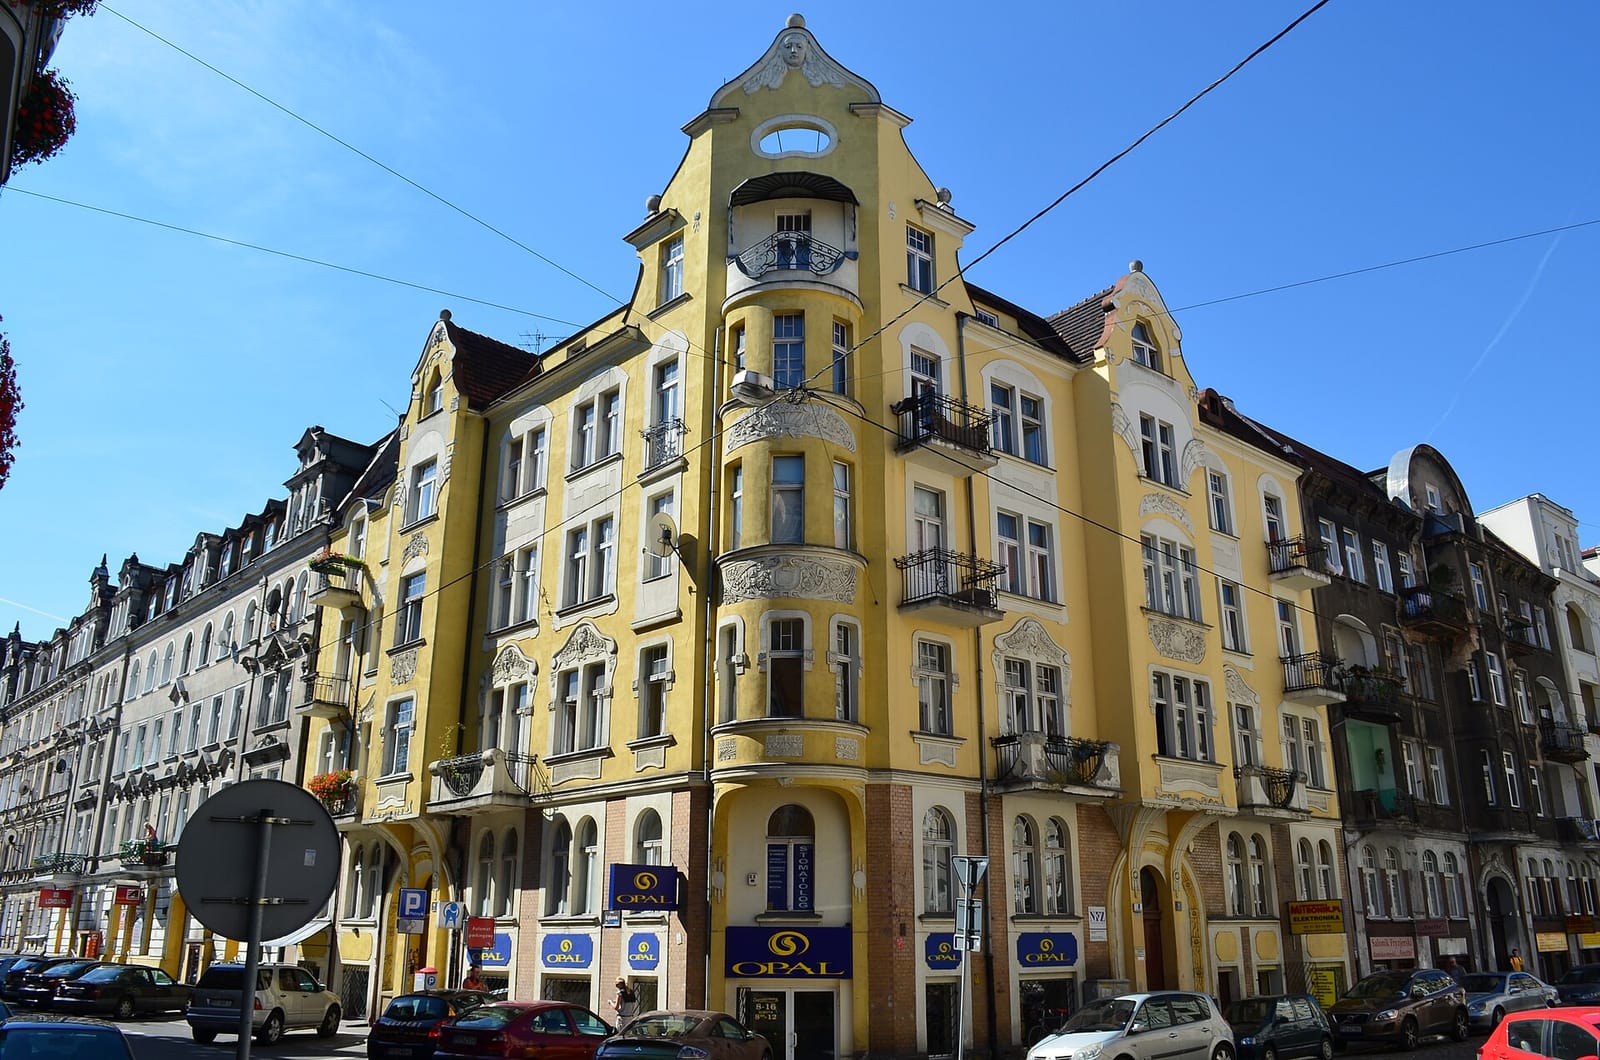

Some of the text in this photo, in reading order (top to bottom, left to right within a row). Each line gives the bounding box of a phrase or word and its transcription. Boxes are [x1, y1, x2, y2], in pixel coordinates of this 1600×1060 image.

[798, 845, 808, 908] STOMATOLOG
[405, 892, 421, 915] P
[616, 894, 672, 904] OPAL
[546, 953, 585, 963] OPAL
[629, 953, 656, 961] OPAL
[1025, 952, 1071, 962] OPAL
[731, 961, 845, 976] OPAL
